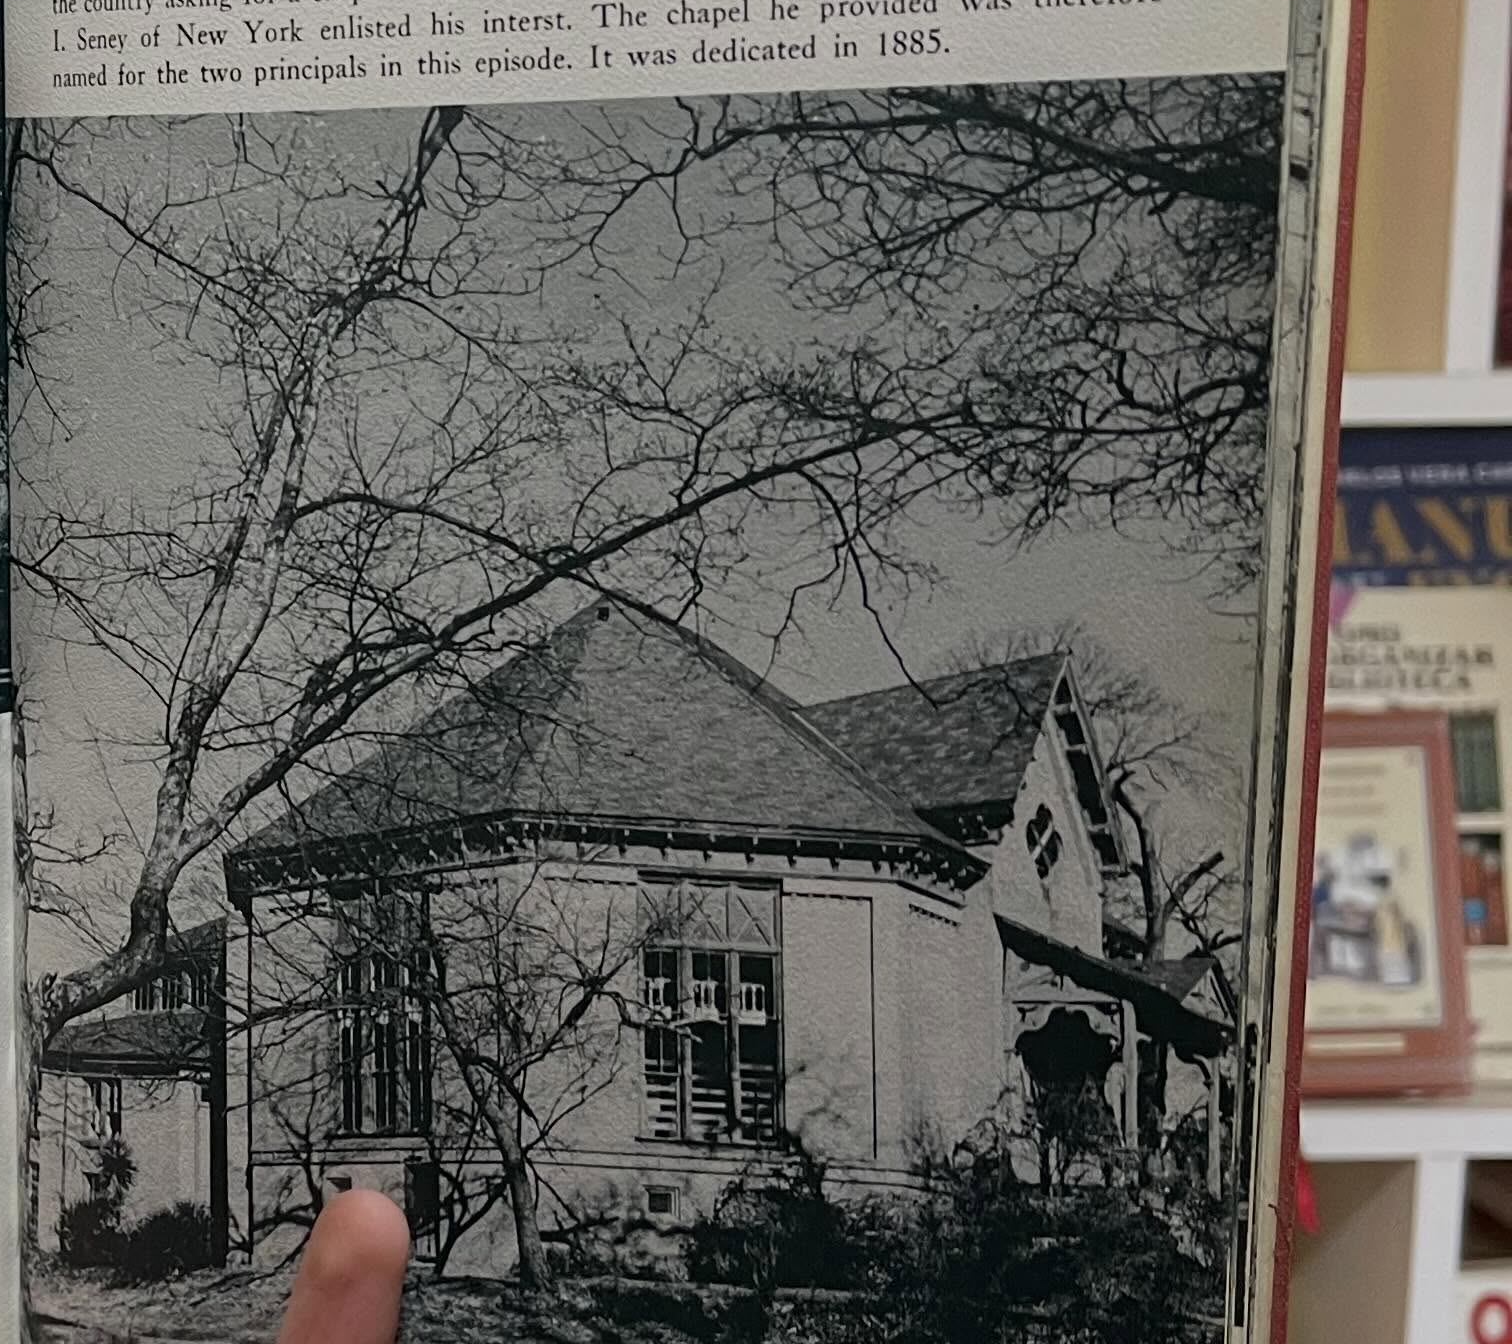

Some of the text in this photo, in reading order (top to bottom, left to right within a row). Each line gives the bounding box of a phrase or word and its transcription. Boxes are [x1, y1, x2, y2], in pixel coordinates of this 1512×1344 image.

[53, 27, 950, 88] named for the two principals in this episode. It was dedicated in 1885.
